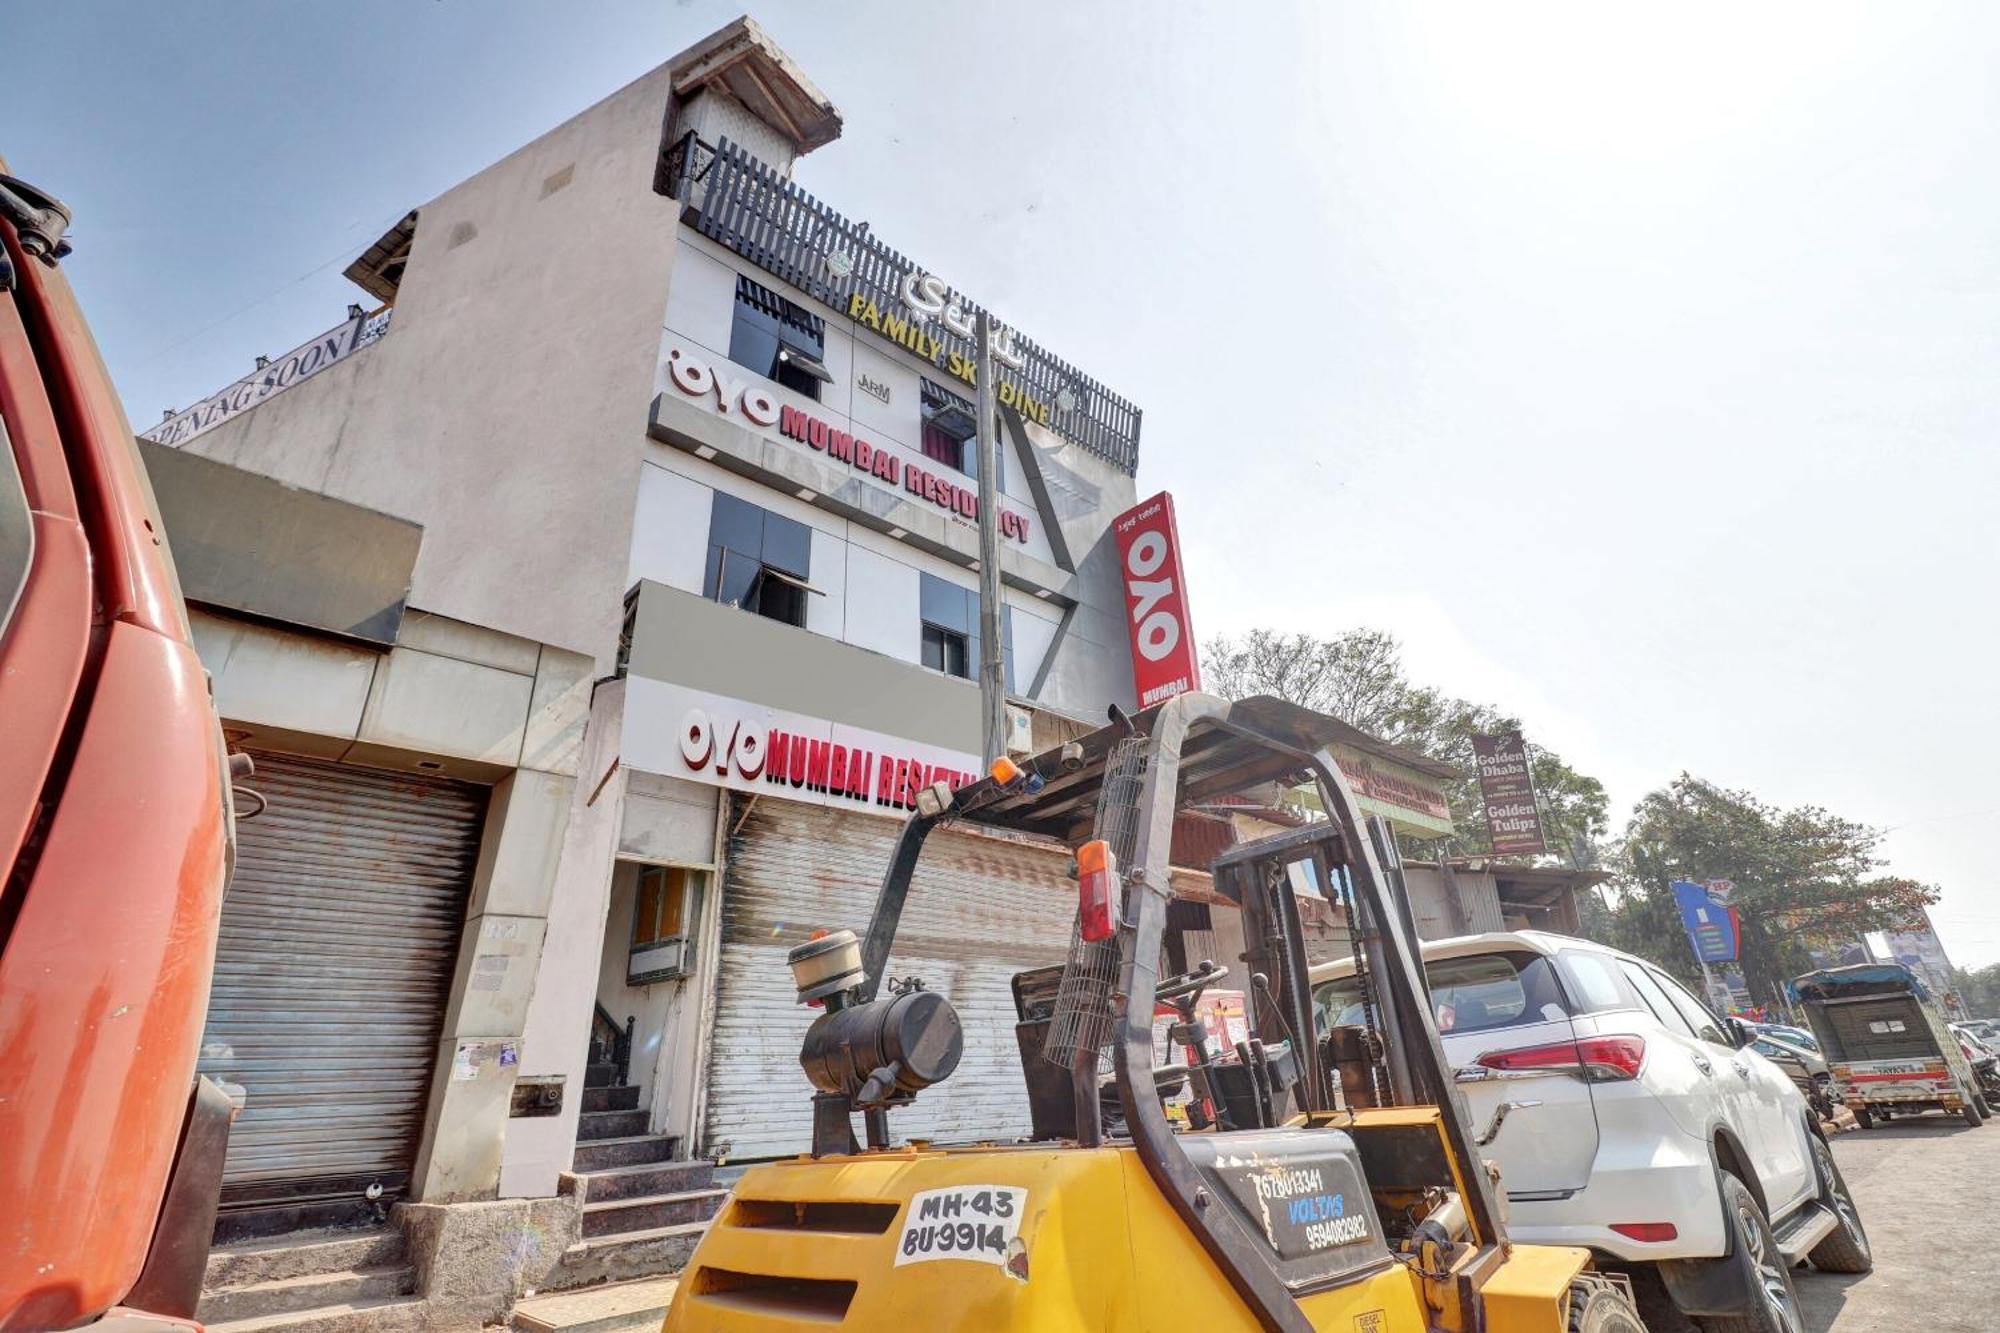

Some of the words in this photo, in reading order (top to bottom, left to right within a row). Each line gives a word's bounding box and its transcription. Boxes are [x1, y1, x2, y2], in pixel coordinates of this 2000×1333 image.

[258, 332, 345, 397] SOON
[850, 293, 942, 363] FAMILY
[949, 351, 977, 386] SK
[998, 381, 1049, 422] DINE
[668, 350, 781, 427] OYO
[780, 404, 900, 485] MUMBAI
[905, 463, 1030, 544] RESIDCY
[1127, 530, 1180, 662] OYO
[1142, 677, 1188, 706] MUMBAI
[680, 708, 766, 781] OYO
[766, 729, 873, 802] MUMBAI
[1478, 752, 1525, 766] Golden
[1483, 764, 1525, 777] Dhaba
[1487, 803, 1535, 818] Golden
[1491, 818, 1537, 832] Tulipz
[1305, 1214, 1368, 1250] 9594082982
